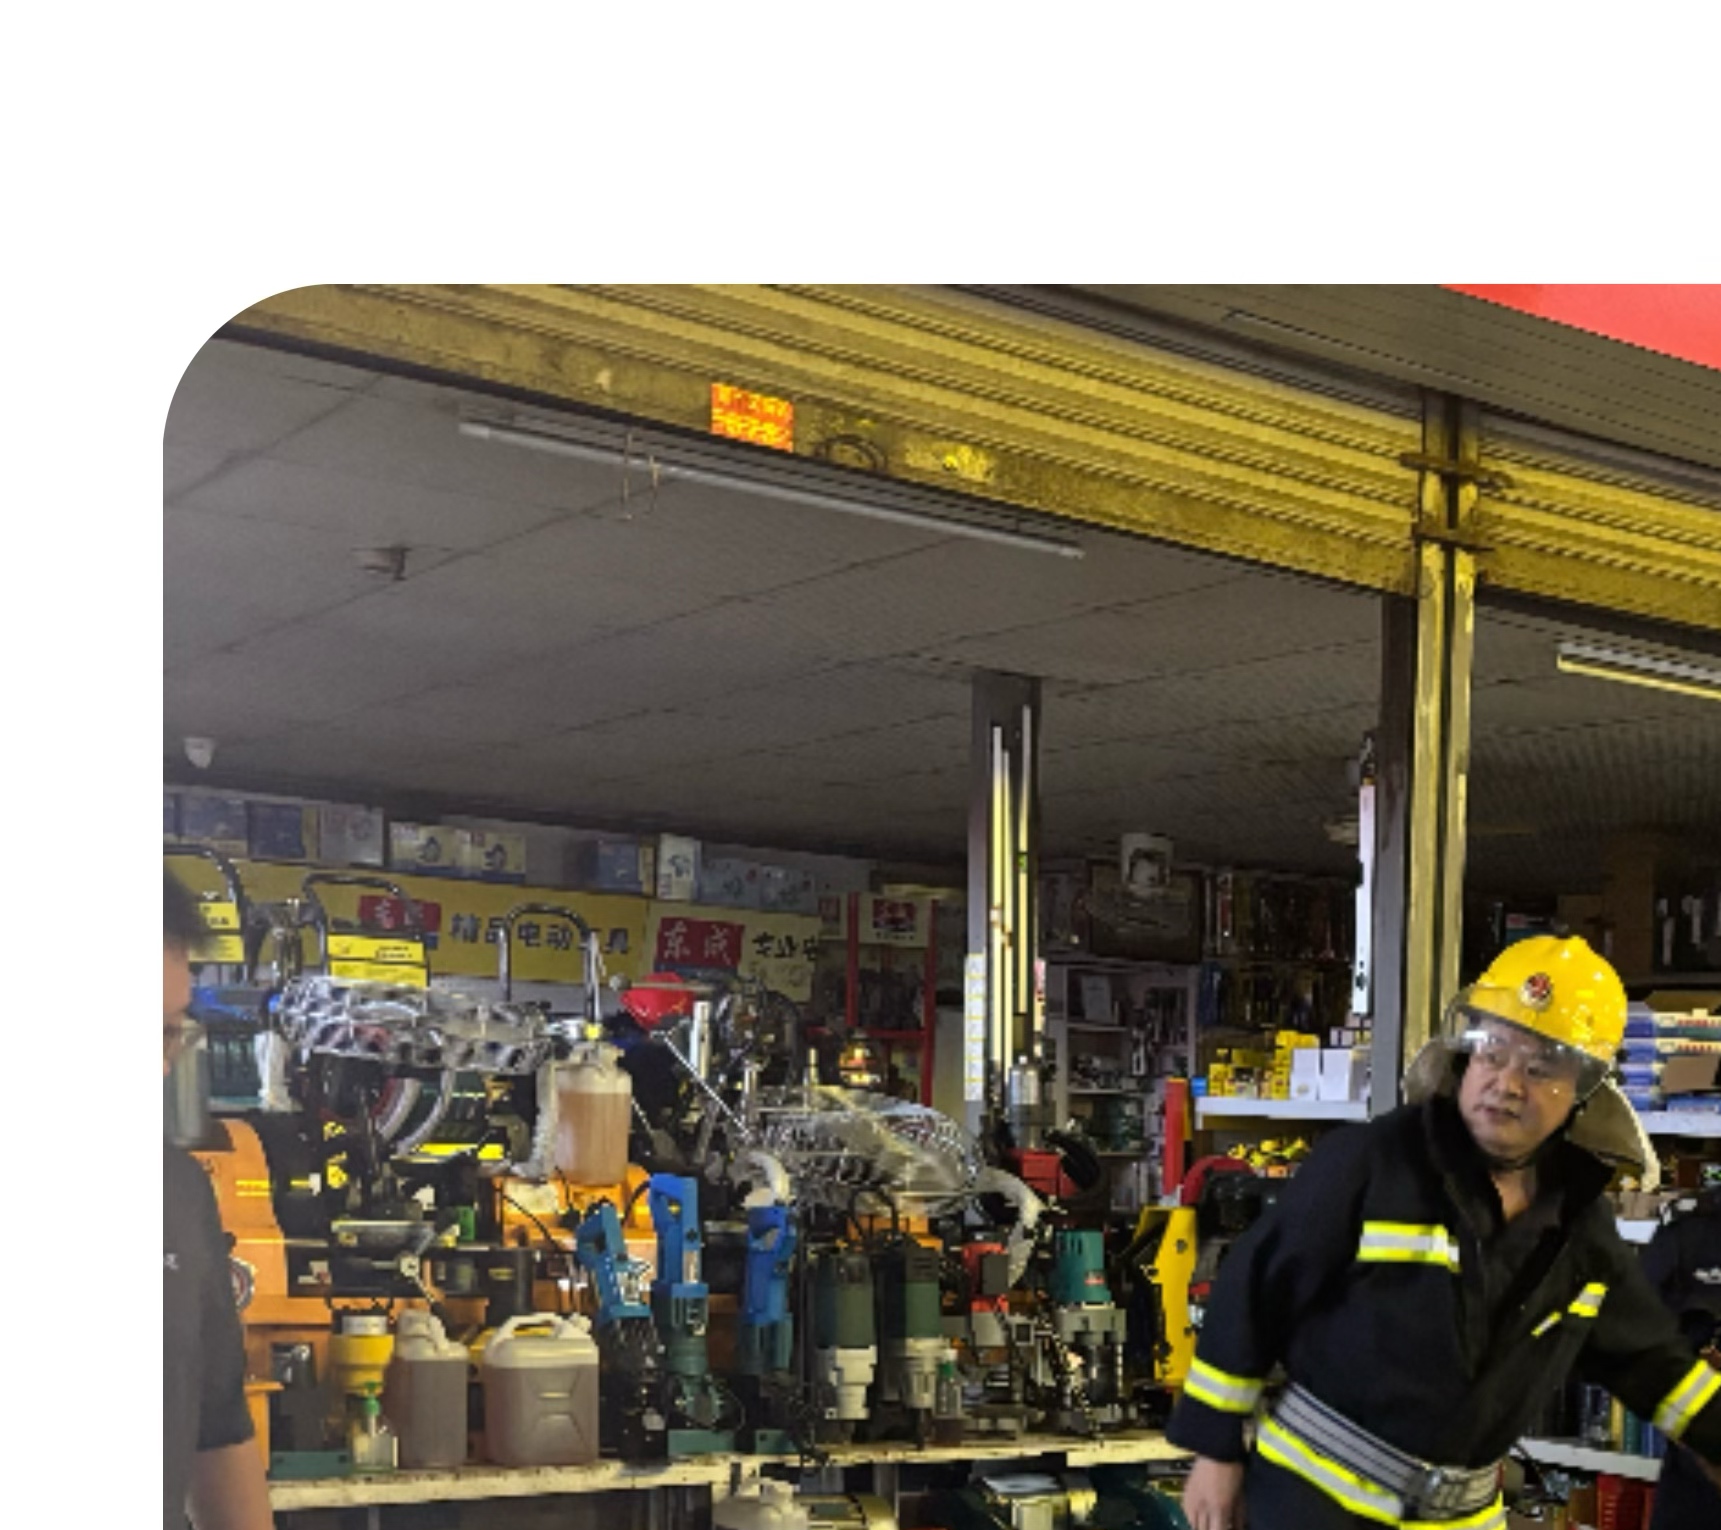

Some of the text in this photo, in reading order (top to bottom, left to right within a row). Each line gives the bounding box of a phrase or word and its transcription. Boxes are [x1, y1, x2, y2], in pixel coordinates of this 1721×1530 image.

[450, 911, 631, 955] 精品电动具
